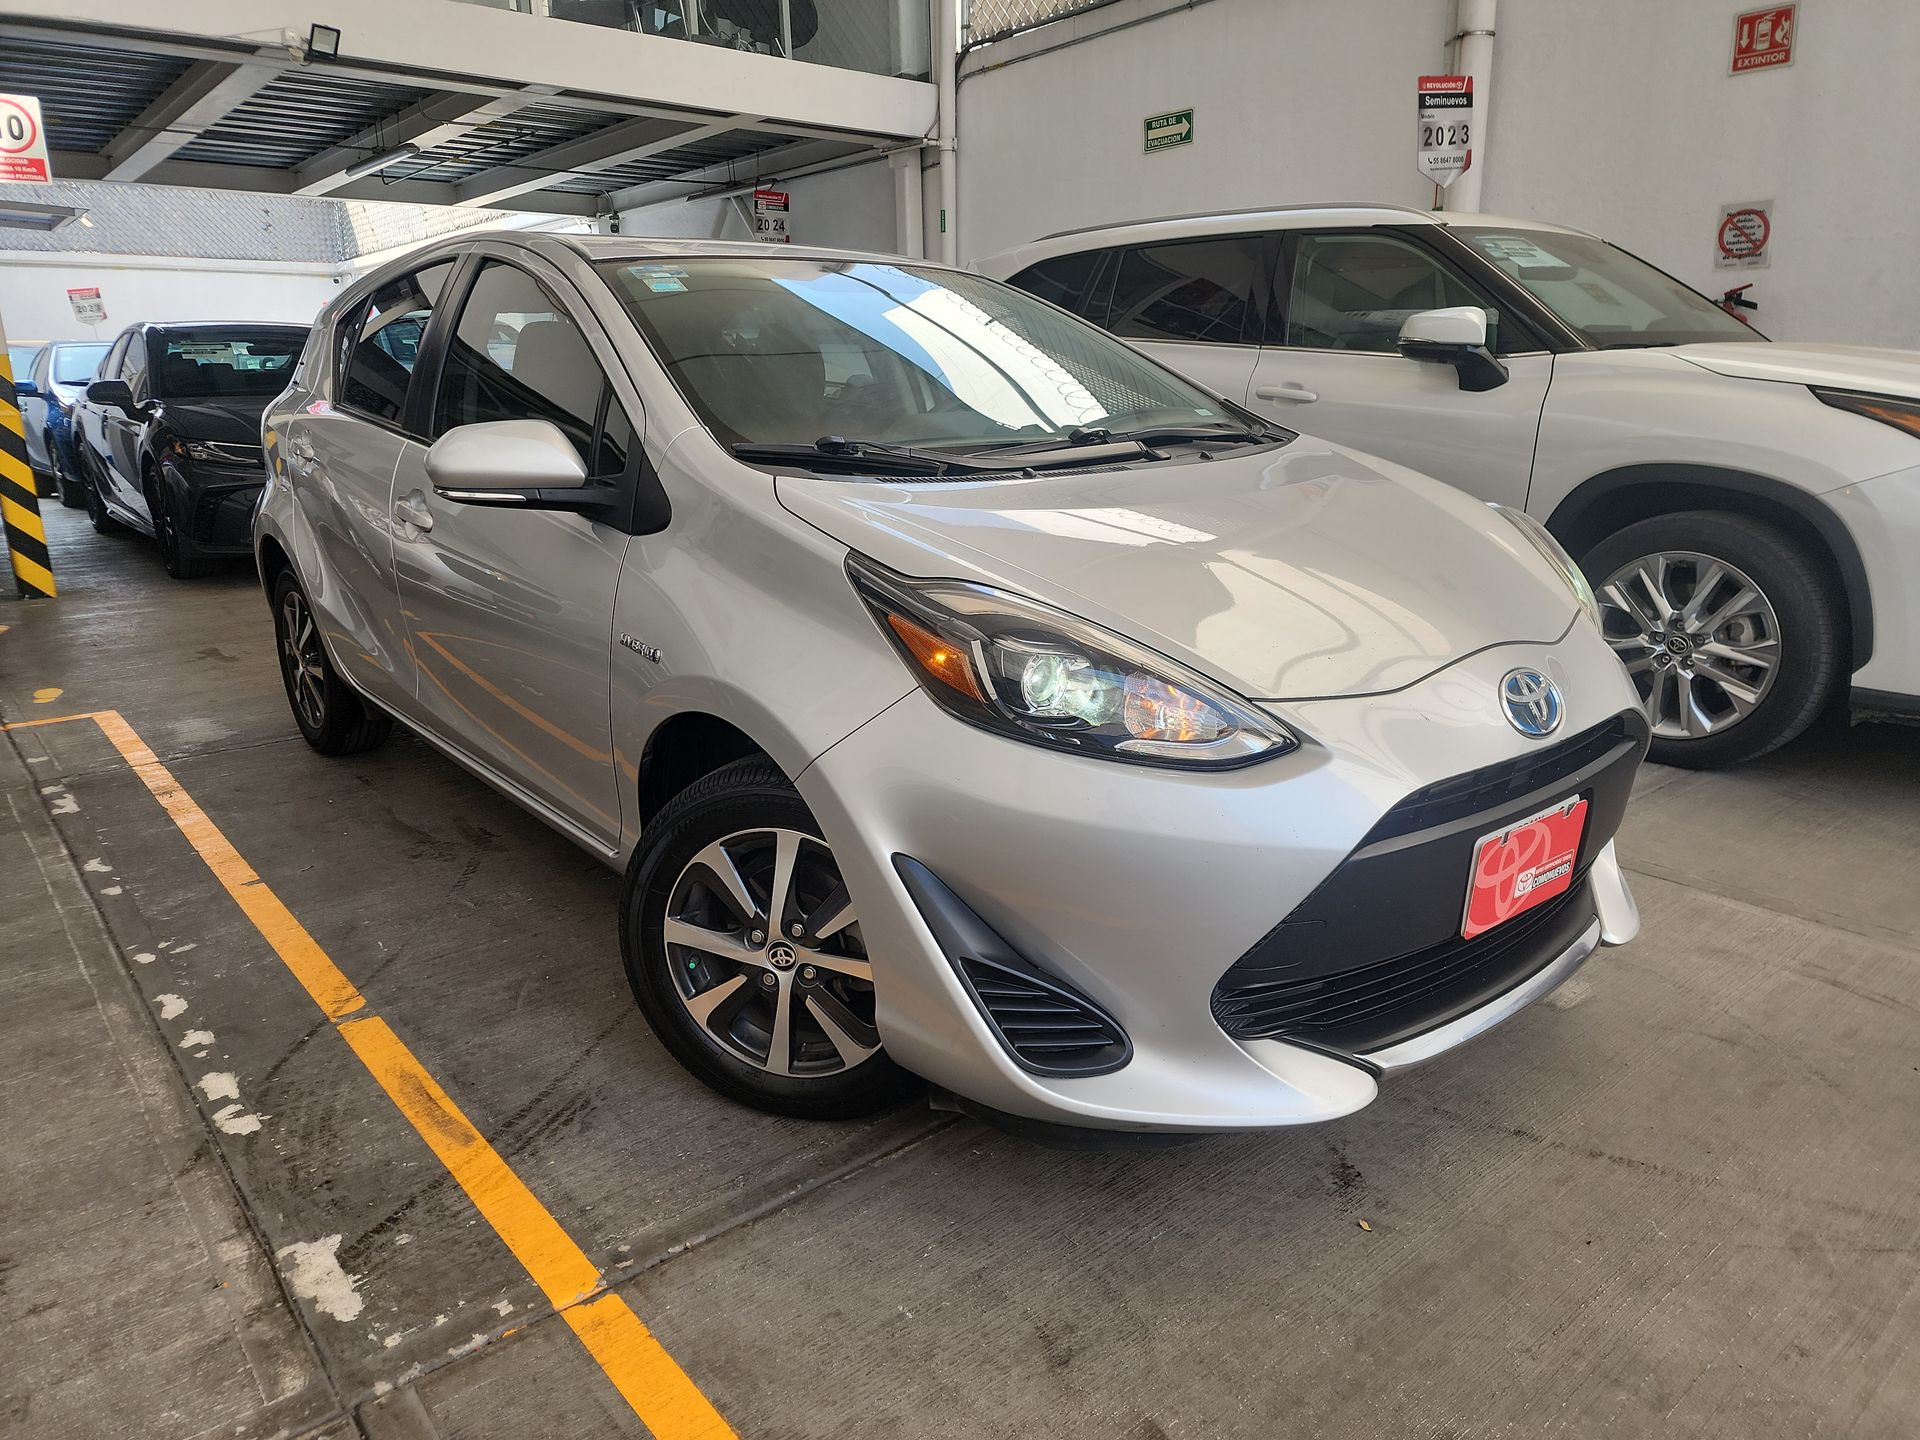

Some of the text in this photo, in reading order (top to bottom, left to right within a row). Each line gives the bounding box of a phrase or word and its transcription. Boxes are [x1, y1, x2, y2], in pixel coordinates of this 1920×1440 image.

[1737, 51, 1787, 68] EXTINTOR
[1425, 95, 1467, 106] Seminuevos
[0, 114, 24, 140] 0
[1151, 119, 1167, 128] RUTA
[1423, 124, 1469, 146] 2023
